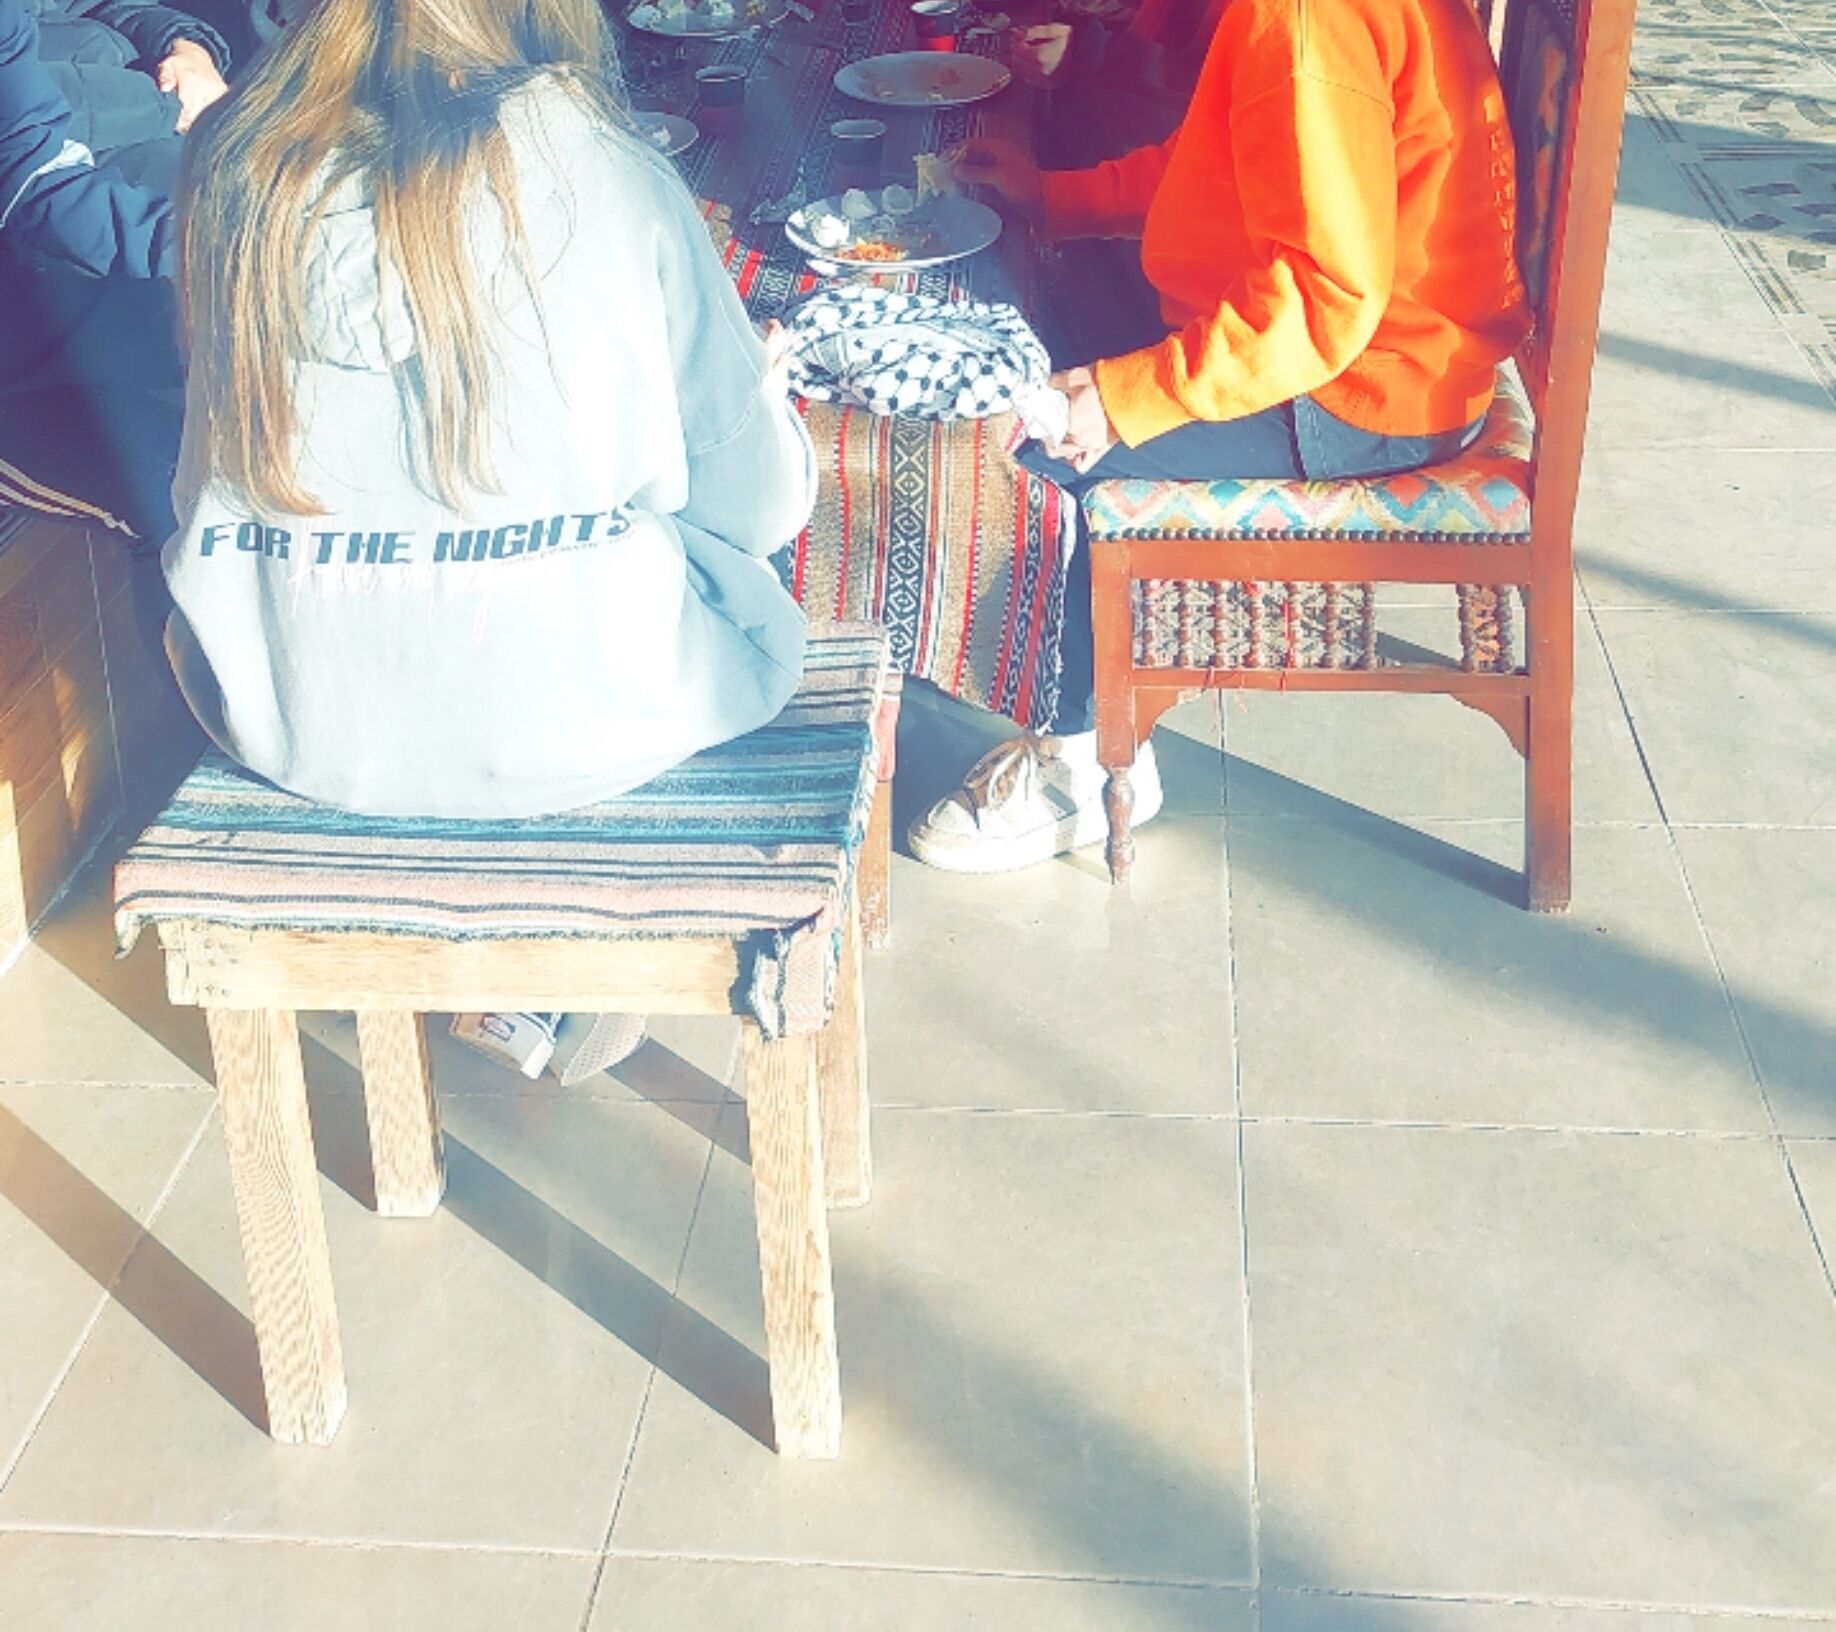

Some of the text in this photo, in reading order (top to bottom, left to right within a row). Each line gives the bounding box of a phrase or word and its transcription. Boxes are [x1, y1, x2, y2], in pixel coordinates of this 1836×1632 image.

[200, 522, 291, 559] FOR
[311, 532, 415, 564] THE
[433, 502, 634, 562] NIGHTS
